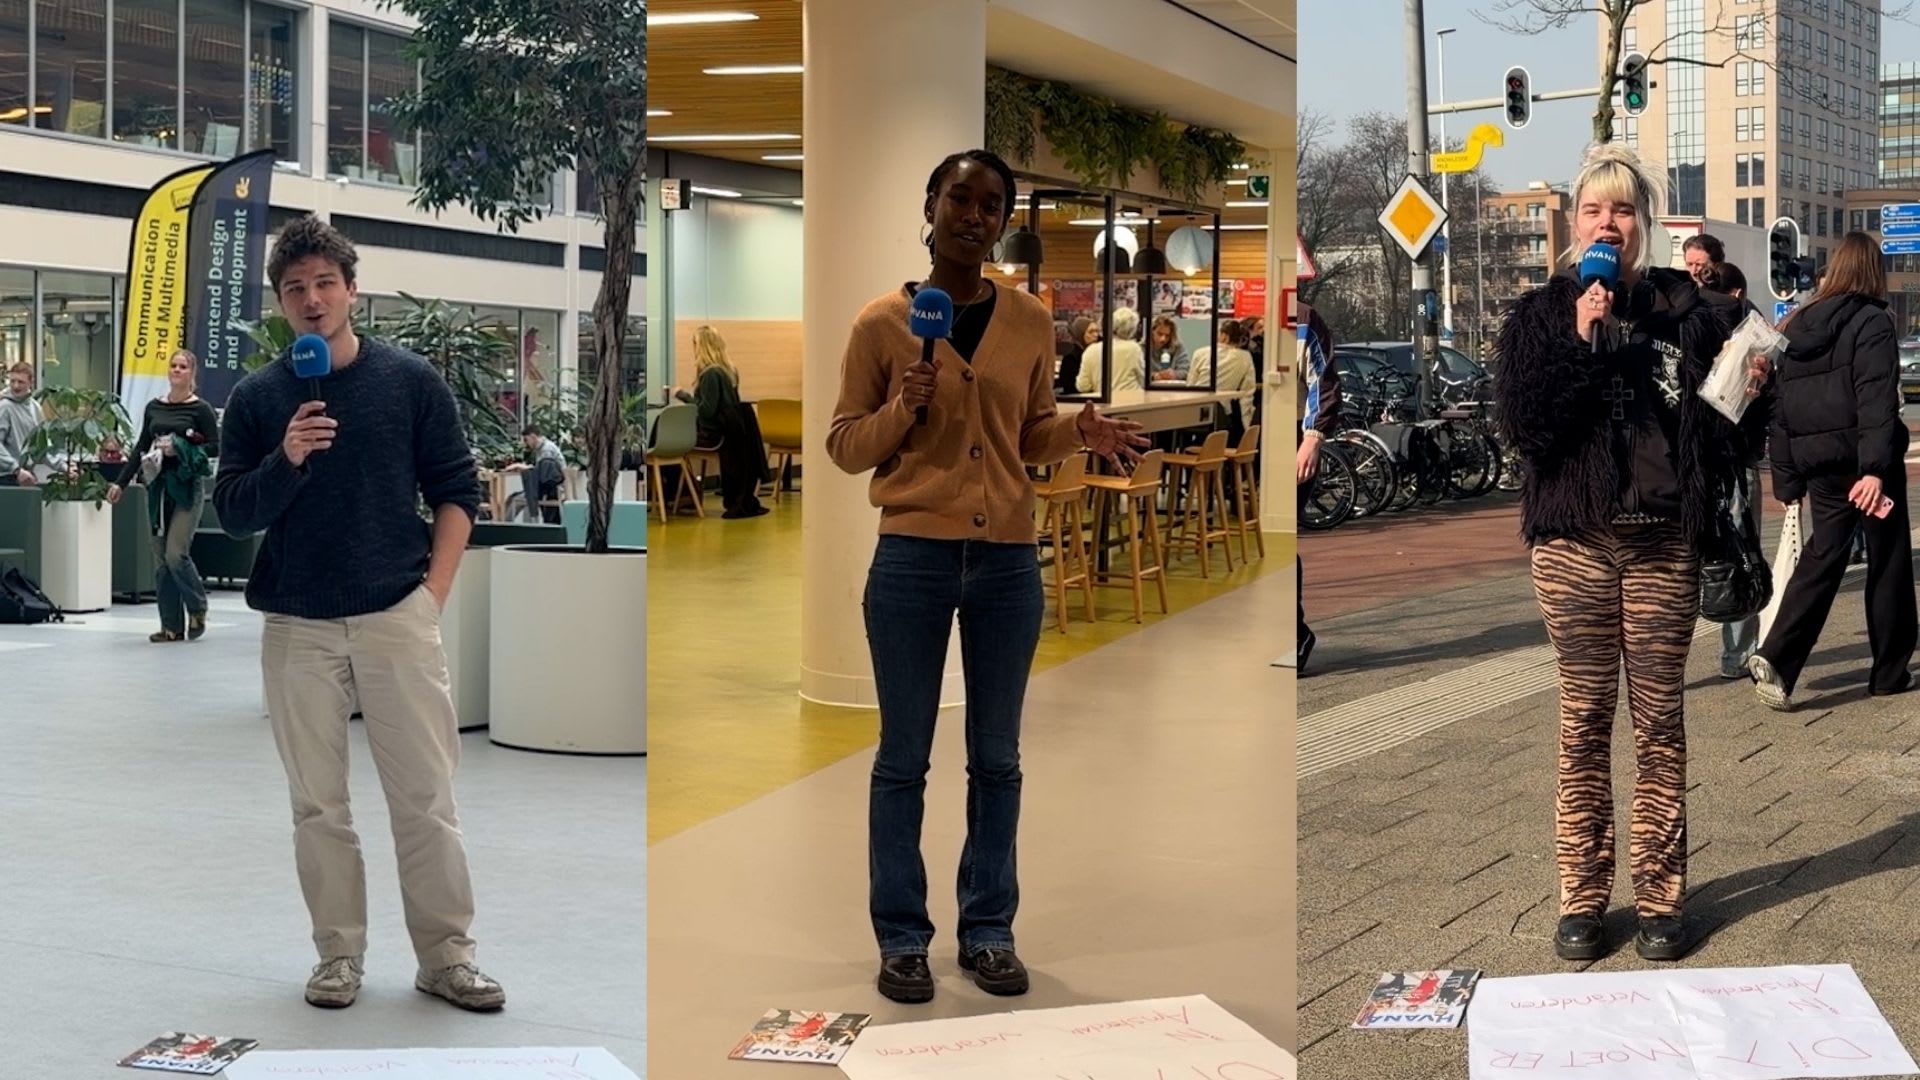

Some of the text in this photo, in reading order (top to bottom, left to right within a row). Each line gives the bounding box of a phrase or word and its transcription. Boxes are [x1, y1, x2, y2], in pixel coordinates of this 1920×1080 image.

[134, 218, 160, 358] Communication
[156, 222, 181, 360] and Multimedia
[205, 219, 229, 368] Frontend Design
[226, 335, 238, 369] and
[1367, 1013, 1454, 1024] HVANA
[1489, 1048, 1544, 1069] ER
[1560, 1036, 1686, 1068] MOET
